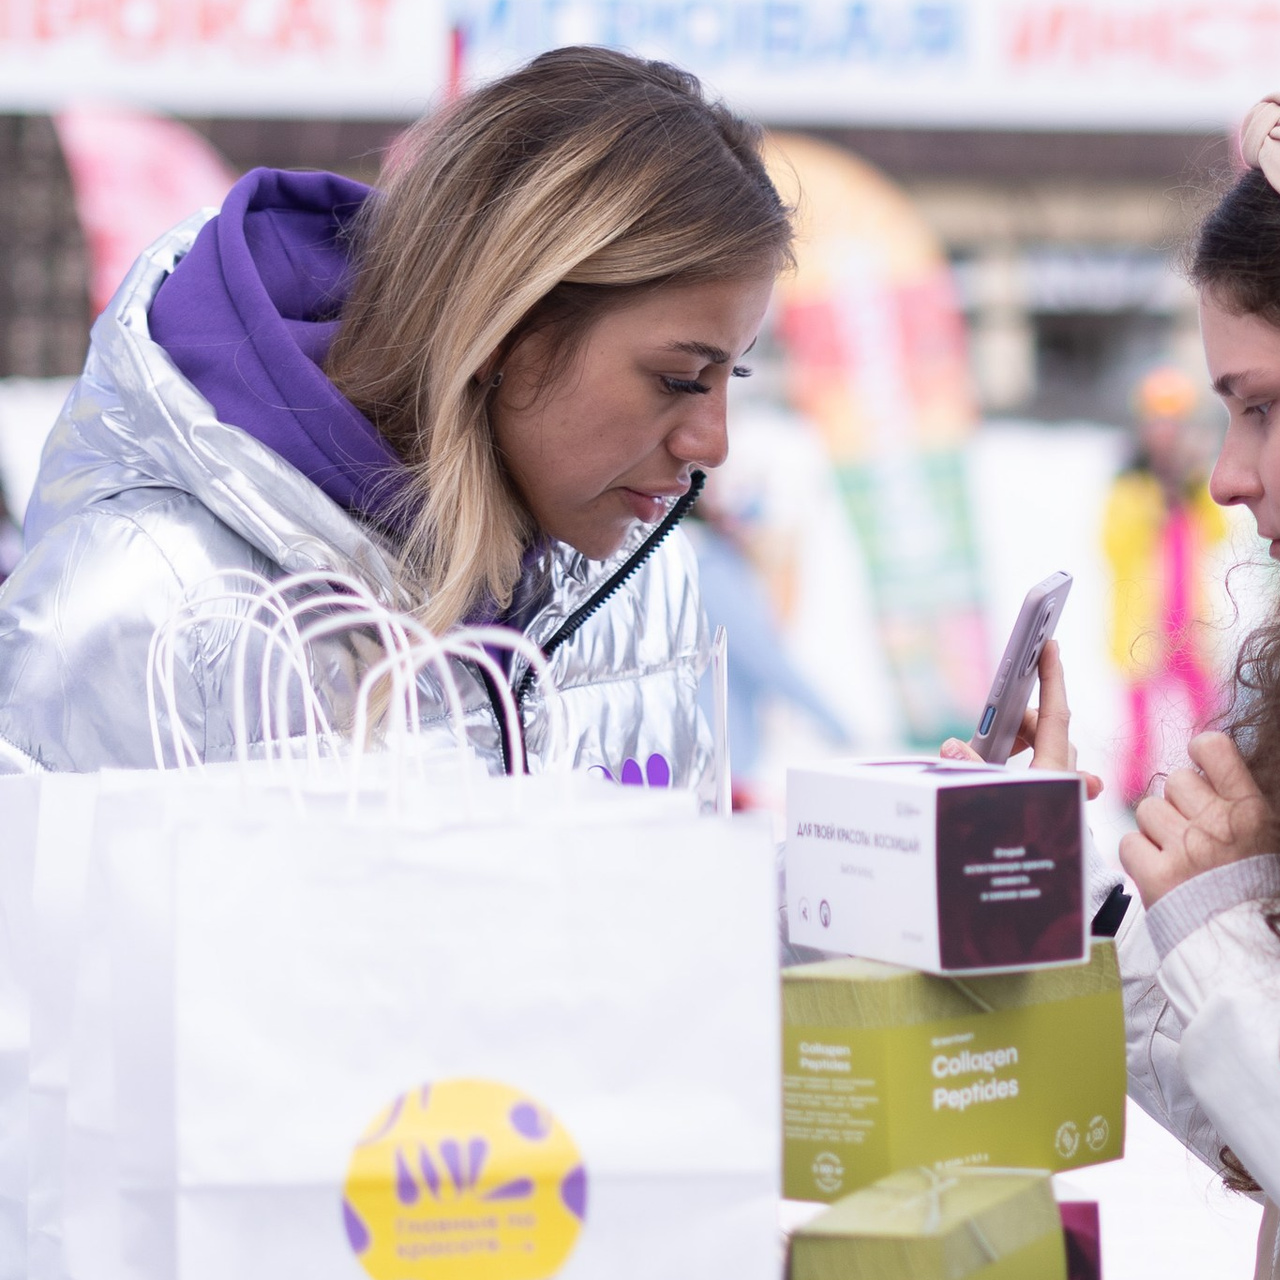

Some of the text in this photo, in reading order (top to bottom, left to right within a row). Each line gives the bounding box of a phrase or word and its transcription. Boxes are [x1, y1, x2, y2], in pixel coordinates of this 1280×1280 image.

[796, 822, 813, 838] ДЛЯ
[799, 1041, 851, 1056] Collagen
[799, 1057, 852, 1072] Peptides
[931, 1046, 1019, 1079] Collagen
[932, 1076, 1020, 1111] Peptides
